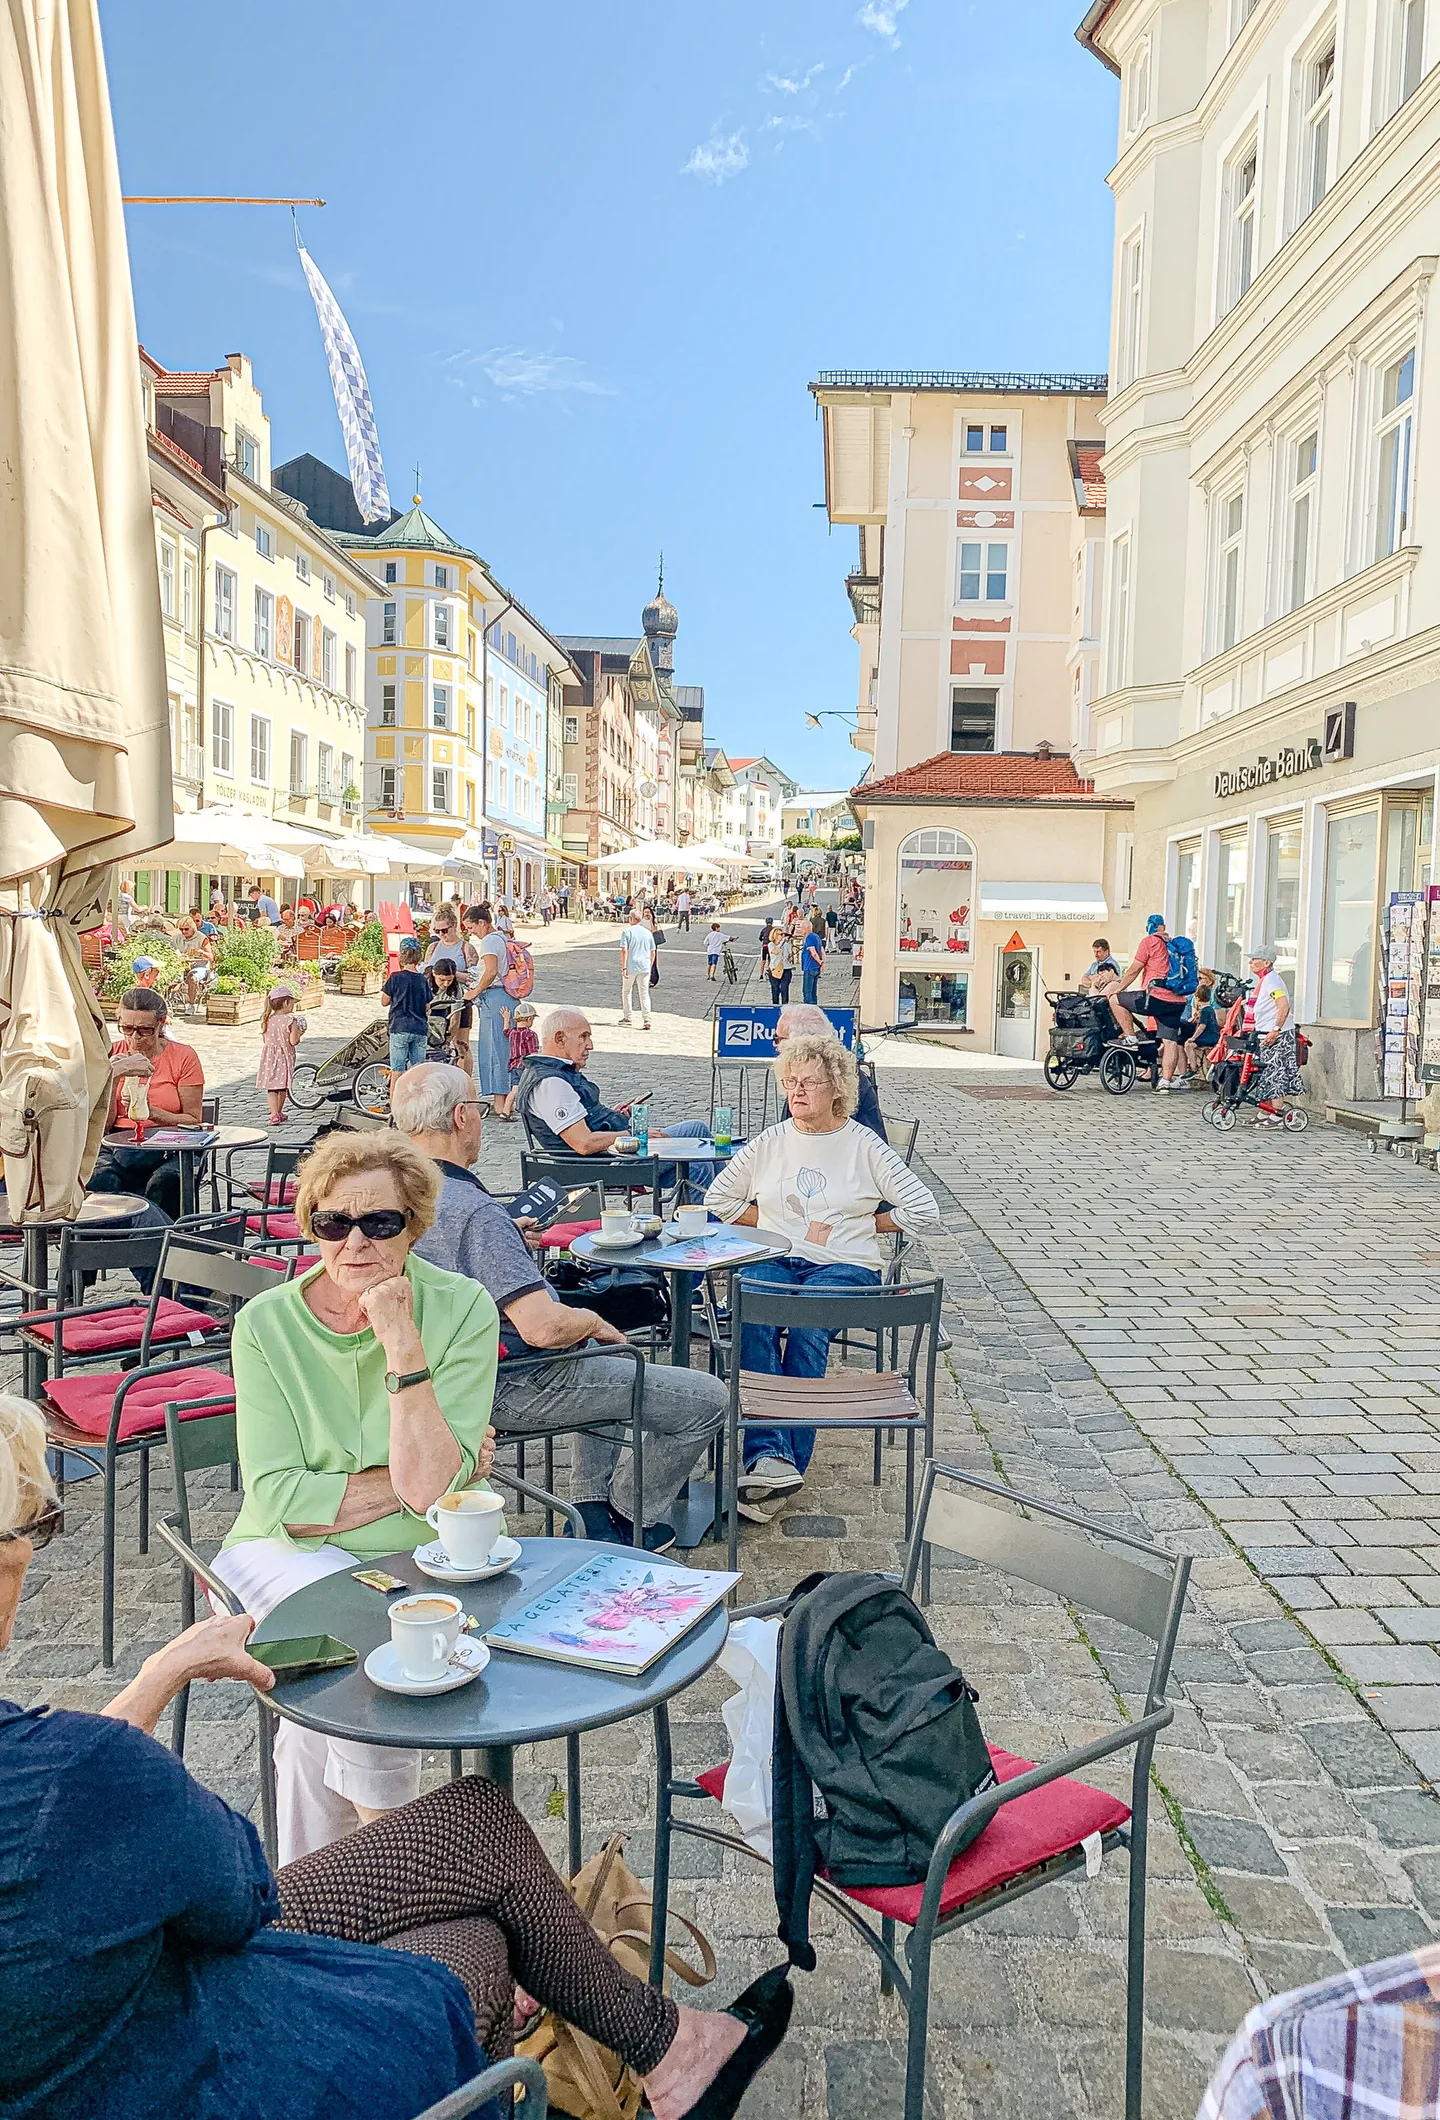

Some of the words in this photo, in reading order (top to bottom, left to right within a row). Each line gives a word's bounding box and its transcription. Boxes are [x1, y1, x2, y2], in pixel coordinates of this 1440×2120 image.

[1213, 757, 1275, 798] Deutsche
[1275, 738, 1322, 779] Bank
[495, 1622, 525, 1638] LA
[525, 1555, 618, 1620] GELATERIA
